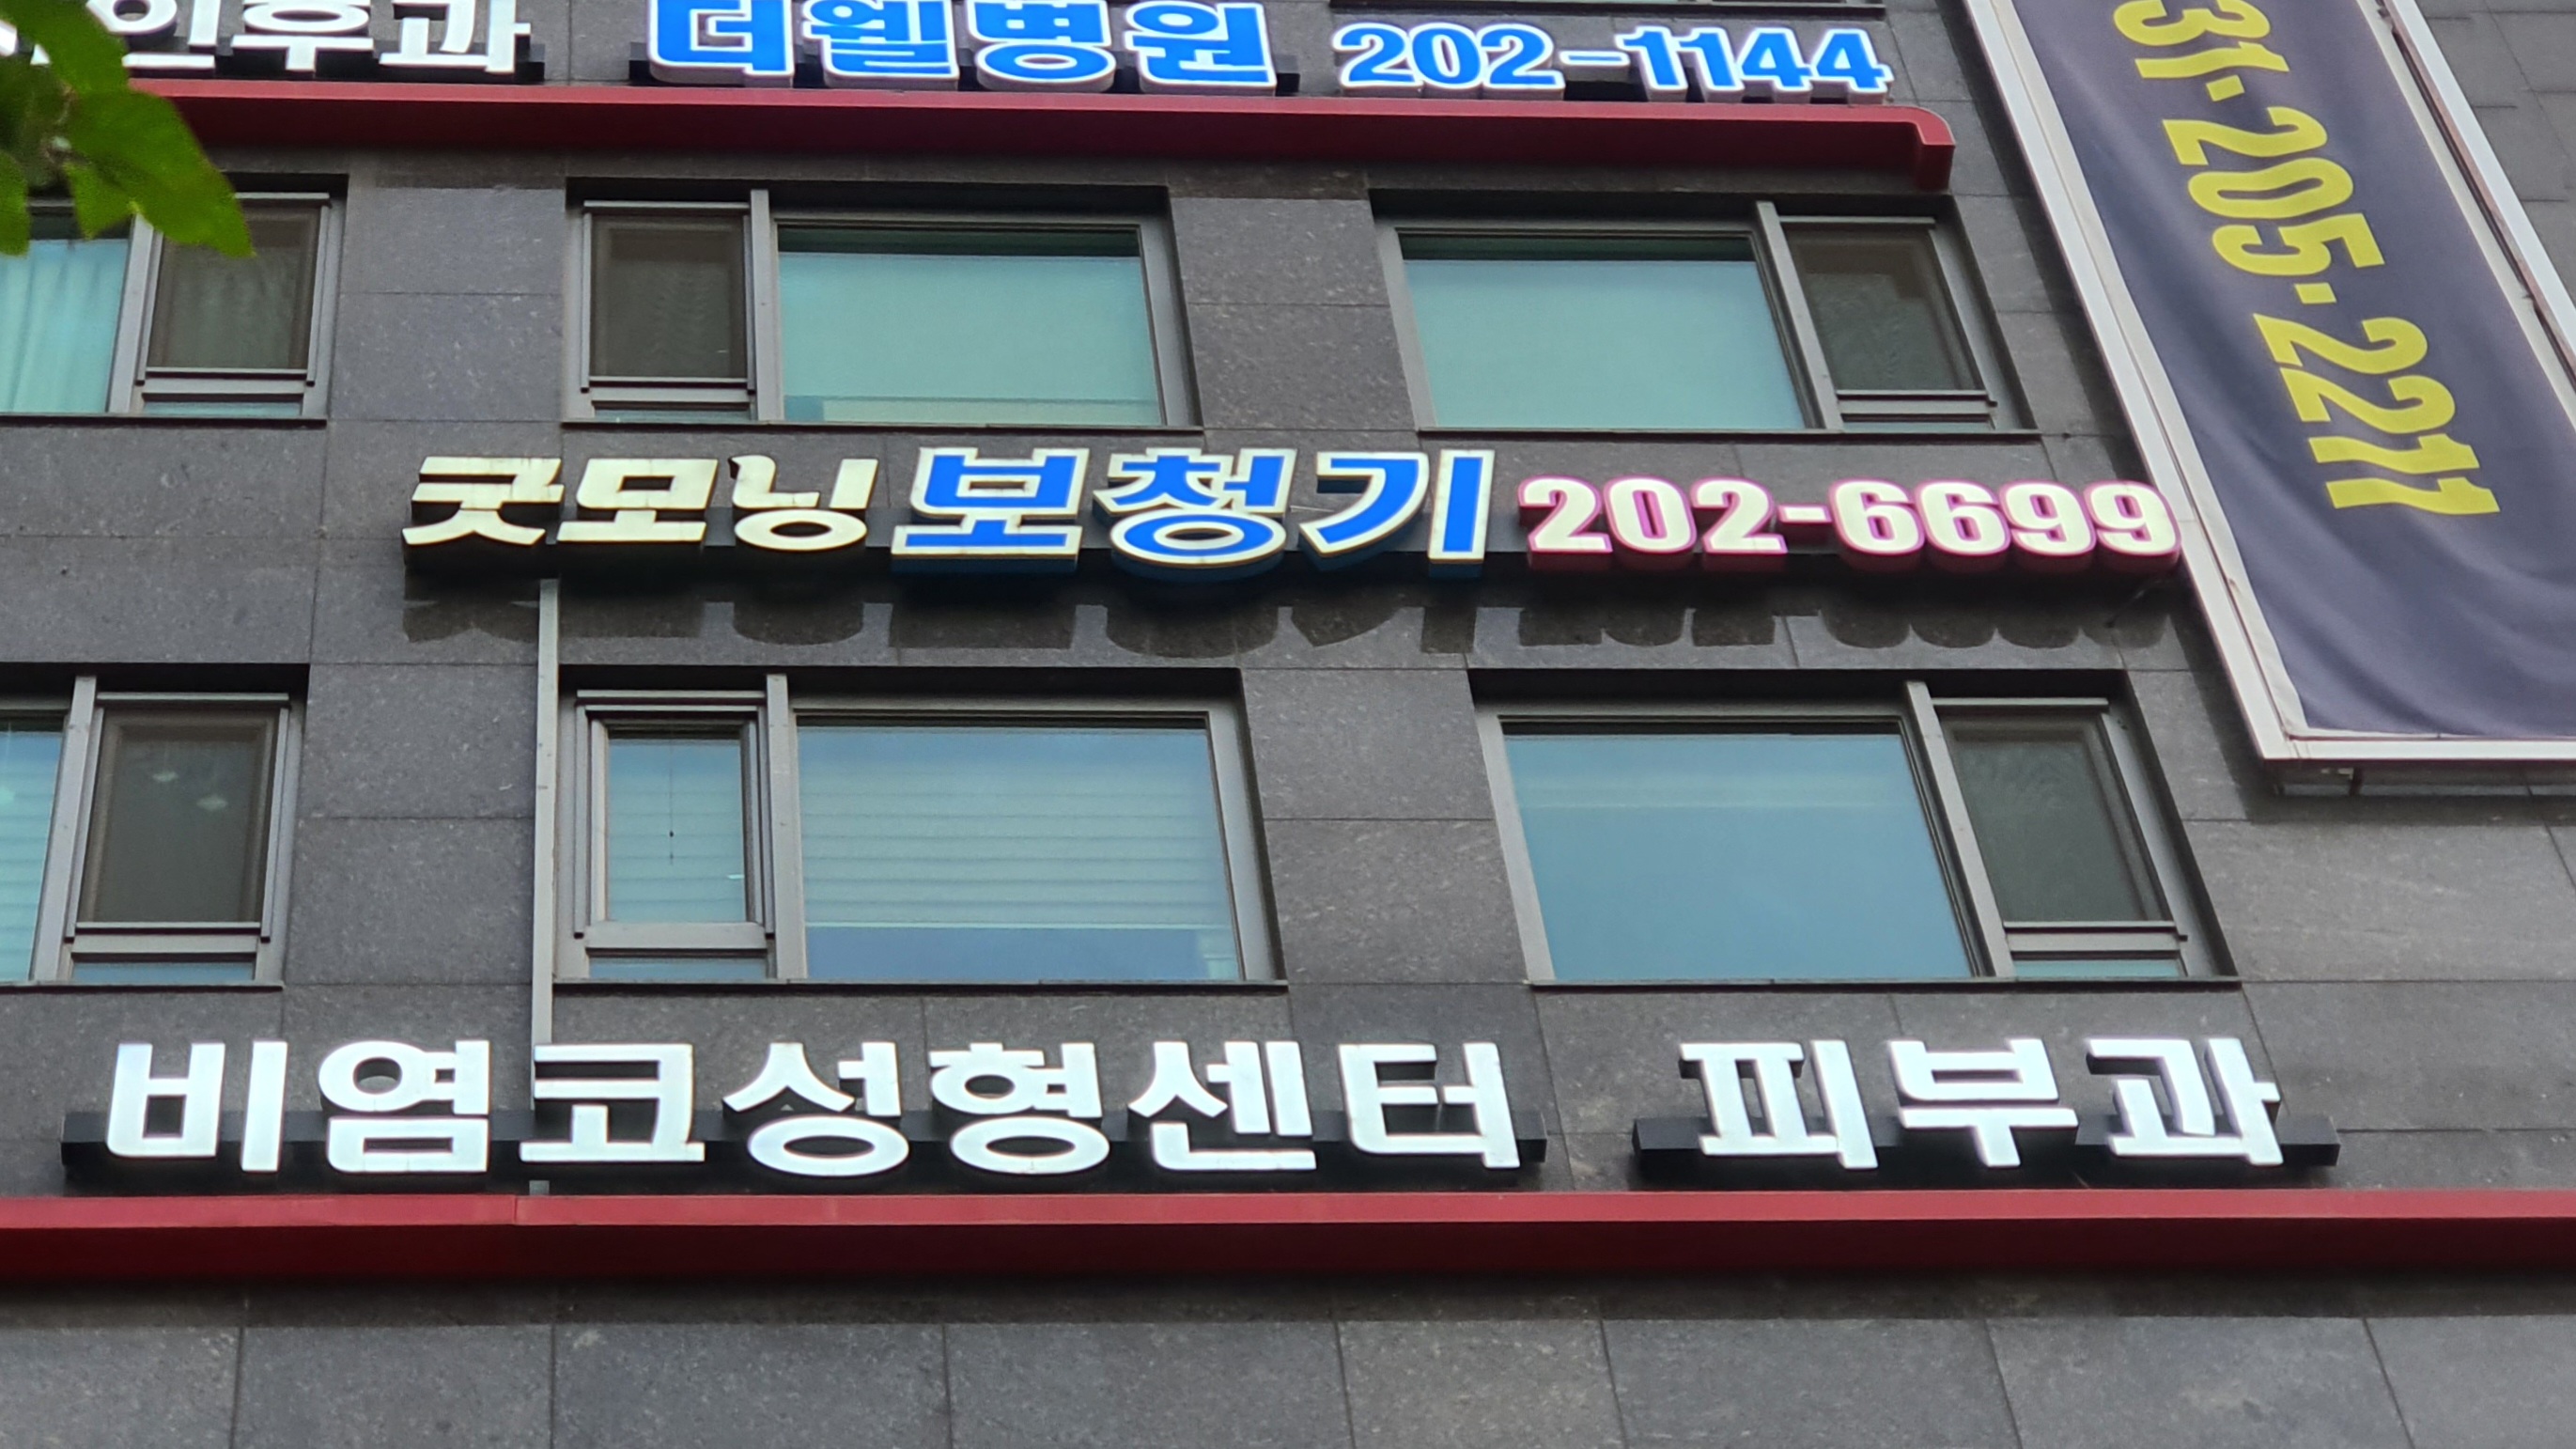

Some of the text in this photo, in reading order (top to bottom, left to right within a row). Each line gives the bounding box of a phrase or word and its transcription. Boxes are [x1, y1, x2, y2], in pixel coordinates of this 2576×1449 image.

[0, 0, 532, 72] 인후과
[647, 0, 1893, 93] 더웰병원 202-1144
[1516, 475, 2181, 558] 202-6699
[1679, 1037, 2282, 1169] 피부과
